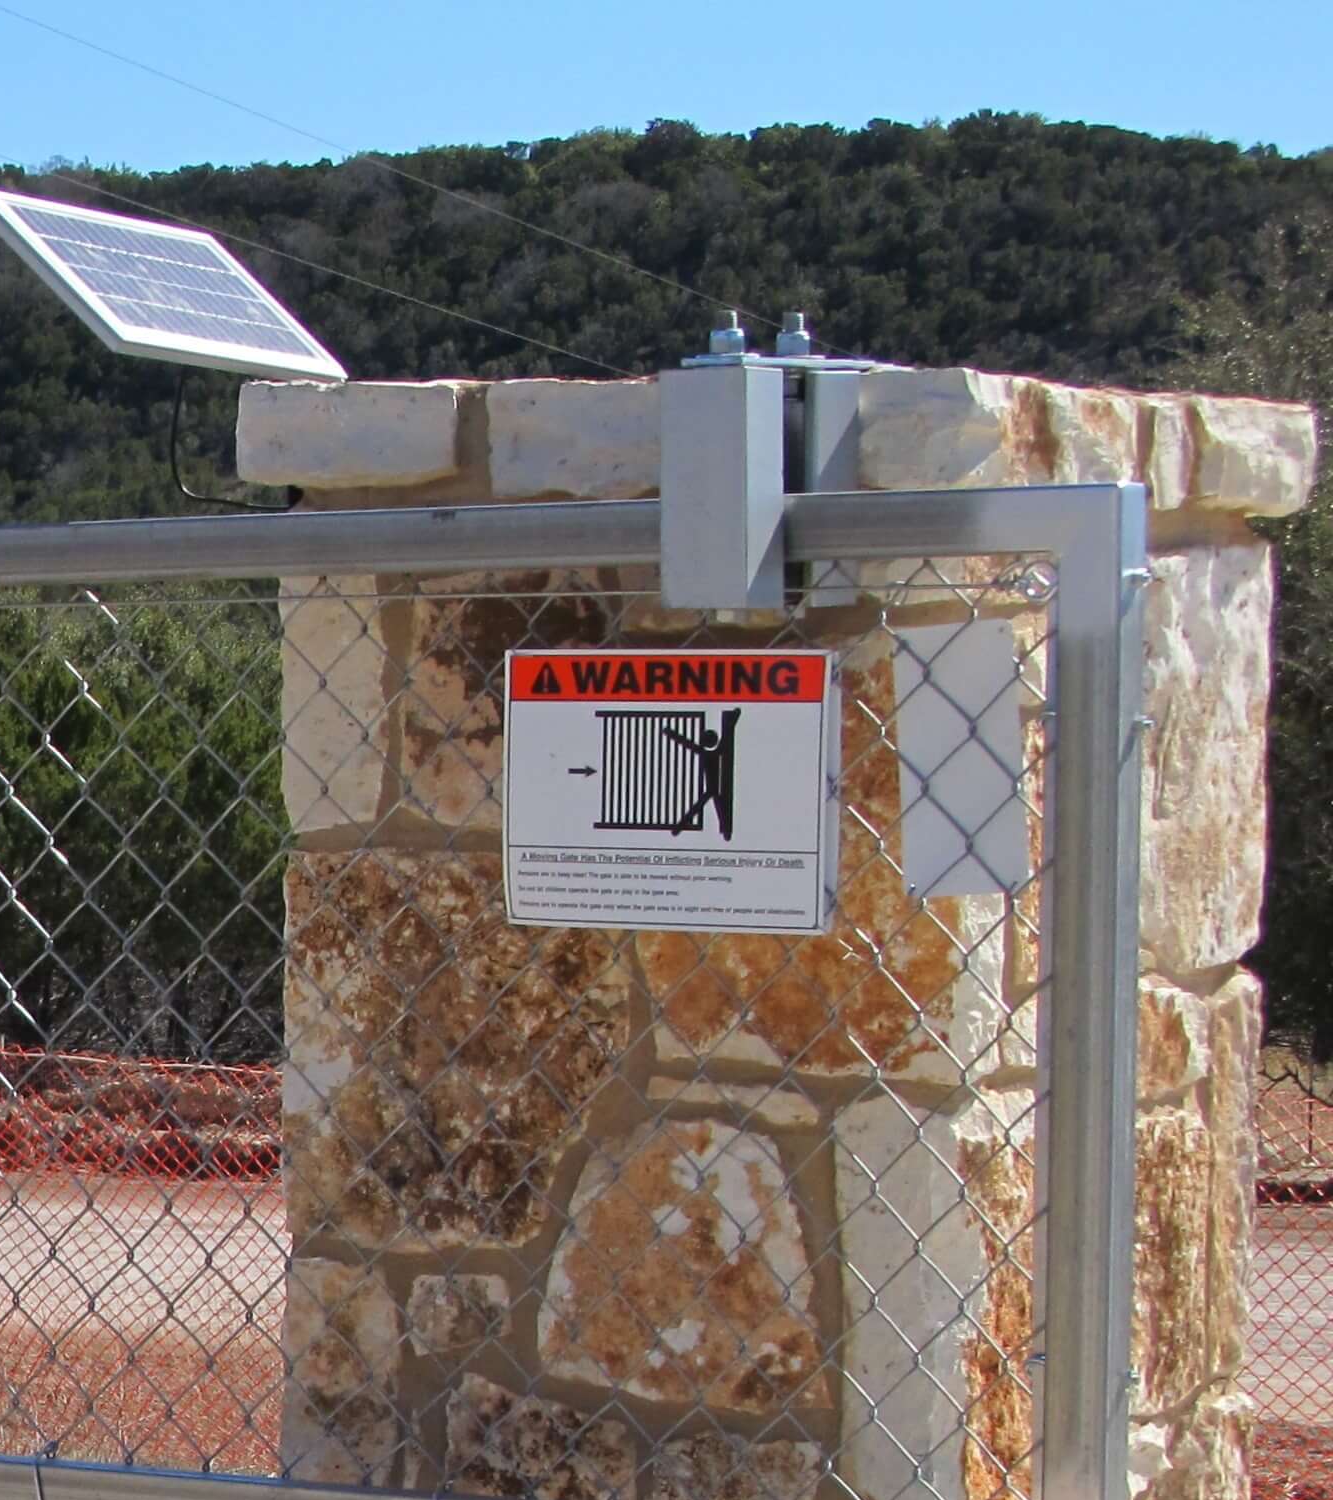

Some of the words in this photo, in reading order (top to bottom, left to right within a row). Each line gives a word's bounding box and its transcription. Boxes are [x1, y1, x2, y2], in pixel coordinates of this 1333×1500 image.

[572, 661, 800, 696] WARNING
[529, 852, 558, 863] Moving
[560, 853, 580, 863] Gate
[581, 853, 596, 863] Has
[597, 854, 613, 863] The
[615, 854, 651, 864] Potential
[665, 856, 702, 866] Inflicting
[703, 856, 737, 867] Serious
[739, 857, 763, 868] Injury
